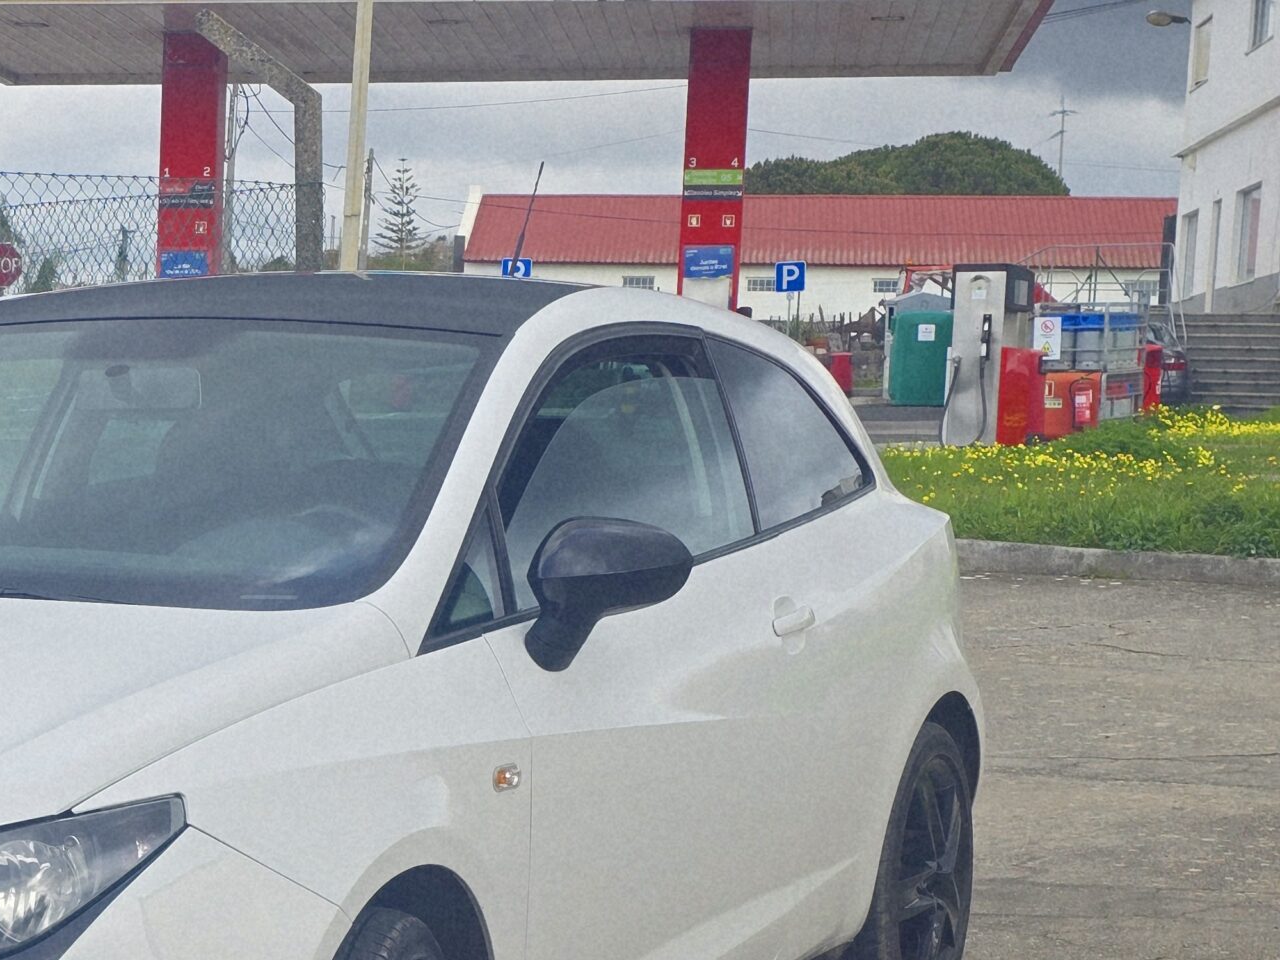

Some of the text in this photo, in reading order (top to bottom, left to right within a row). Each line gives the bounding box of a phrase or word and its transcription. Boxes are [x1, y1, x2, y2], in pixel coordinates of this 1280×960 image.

[688, 157, 739, 168] 3 4
[164, 166, 211, 178] 1 2
[782, 264, 800, 290] P
